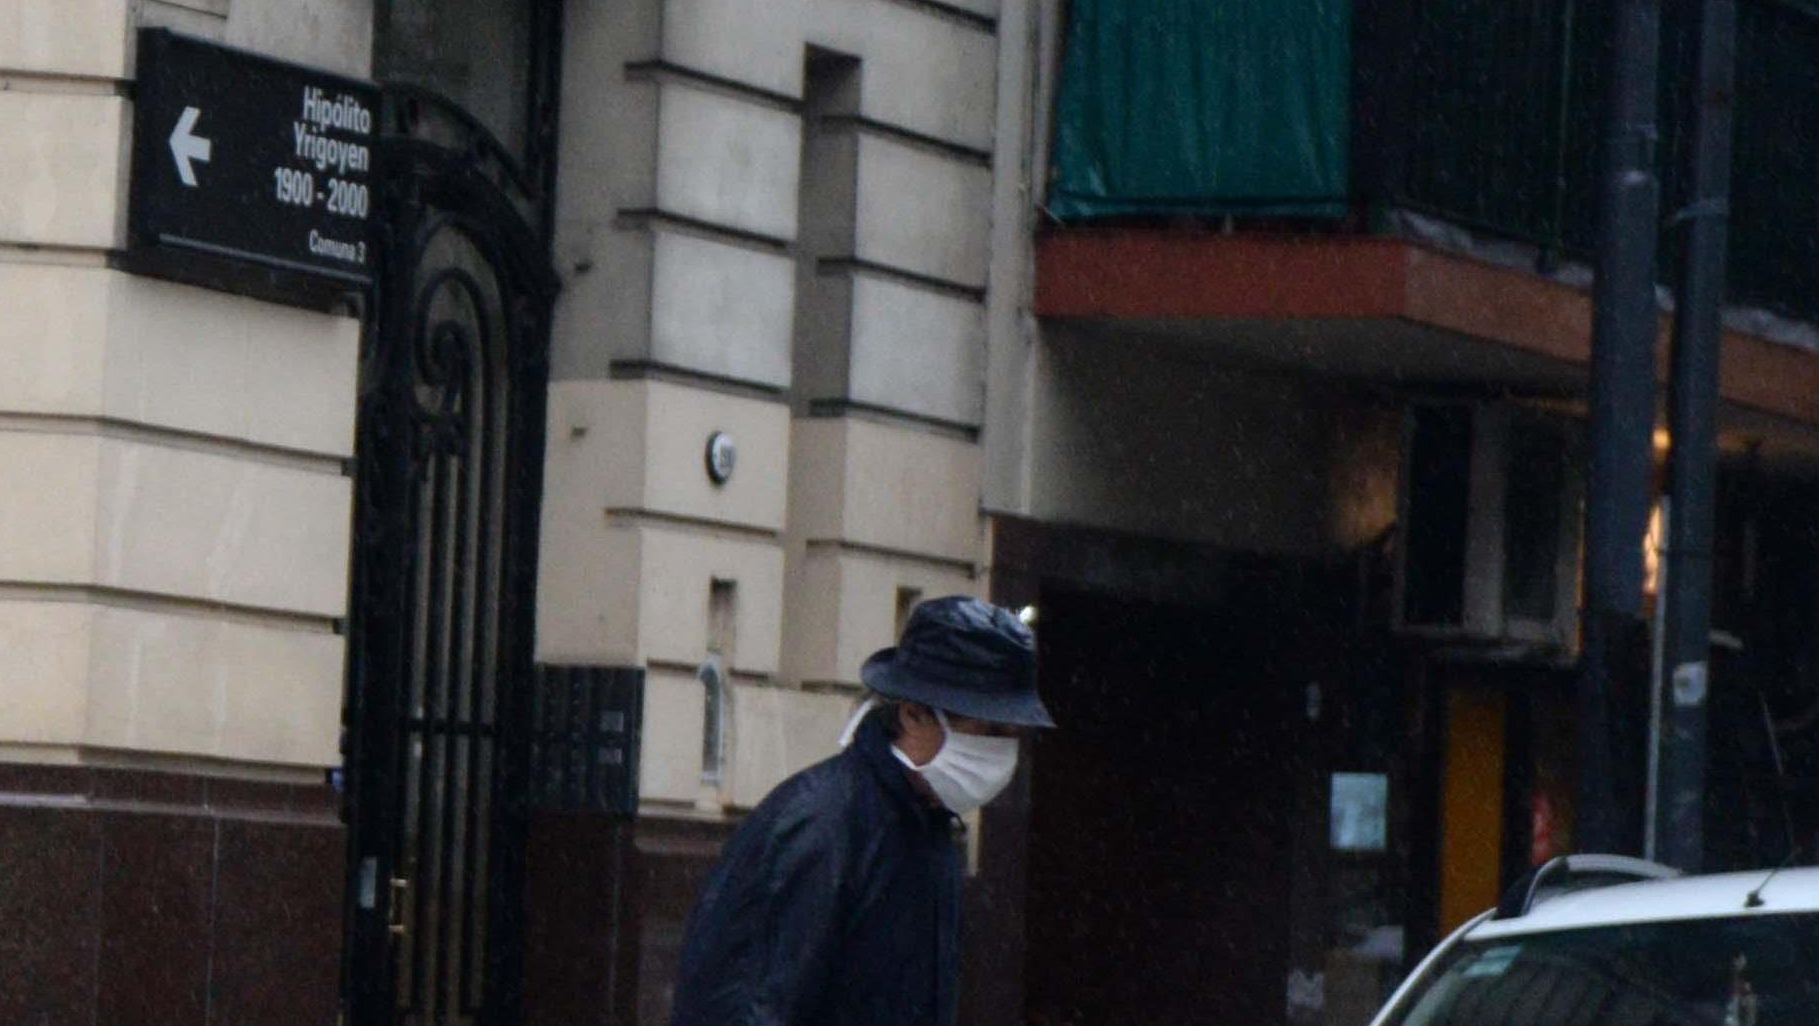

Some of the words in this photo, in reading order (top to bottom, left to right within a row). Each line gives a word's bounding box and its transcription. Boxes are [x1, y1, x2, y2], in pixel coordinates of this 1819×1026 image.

[303, 86, 371, 134] Hipólito
[294, 121, 369, 174] Yrigoyen
[275, 166, 313, 207] 1900
[327, 177, 368, 218] 2000
[309, 228, 356, 263] Comuna
[357, 241, 365, 265] 3
